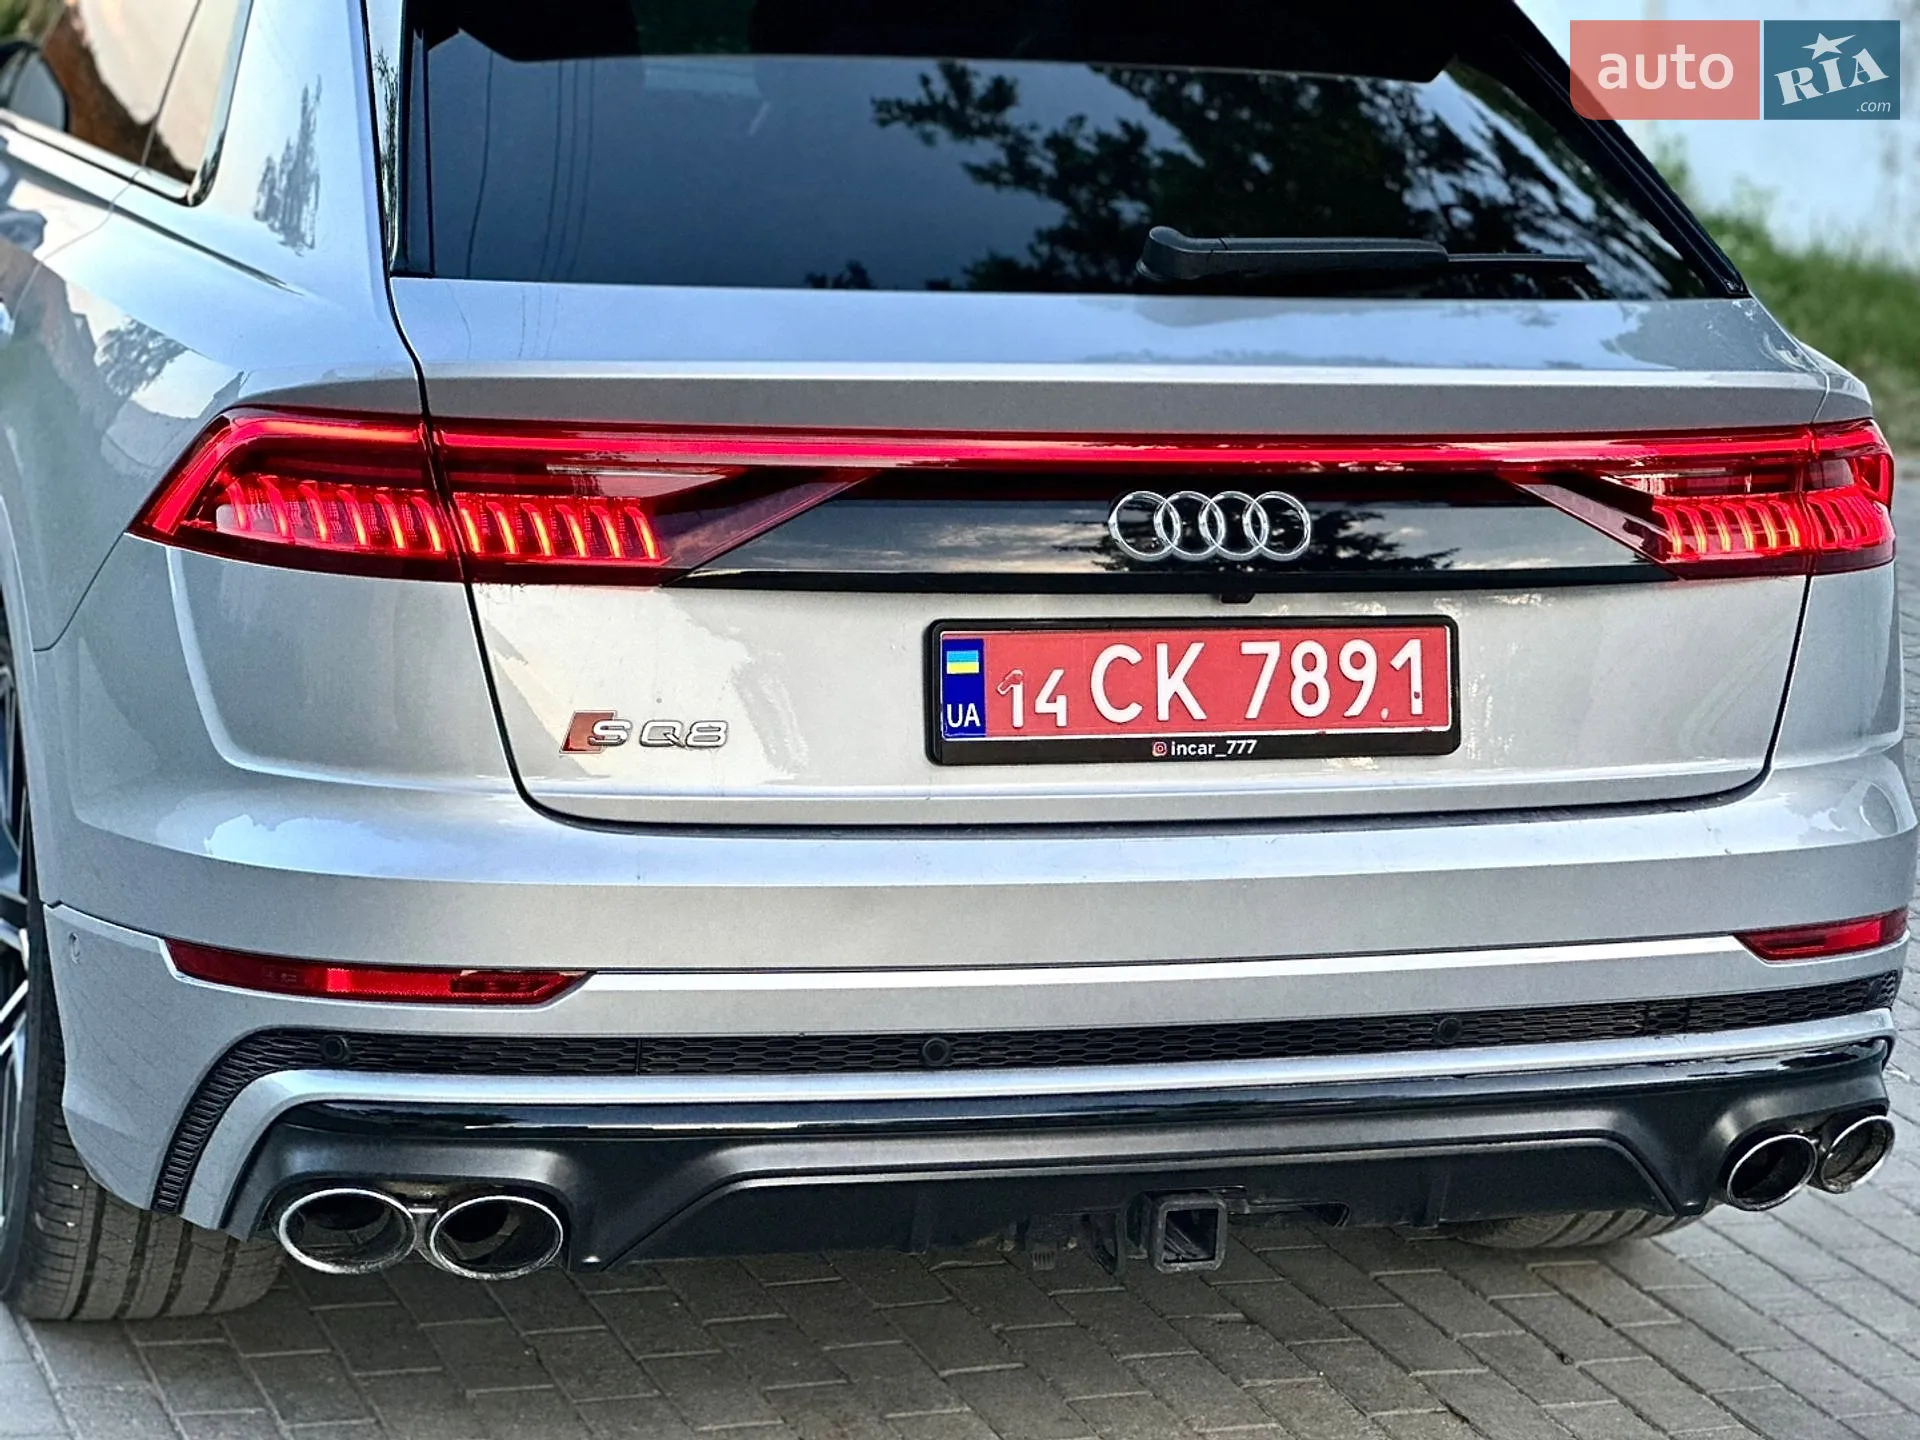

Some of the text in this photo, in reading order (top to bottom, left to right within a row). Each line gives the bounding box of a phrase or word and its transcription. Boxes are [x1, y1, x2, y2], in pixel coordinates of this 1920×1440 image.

[997, 639, 1424, 728] 14 CK 7891
[947, 704, 982, 728] UA
[1171, 740, 1258, 758] incar_777
